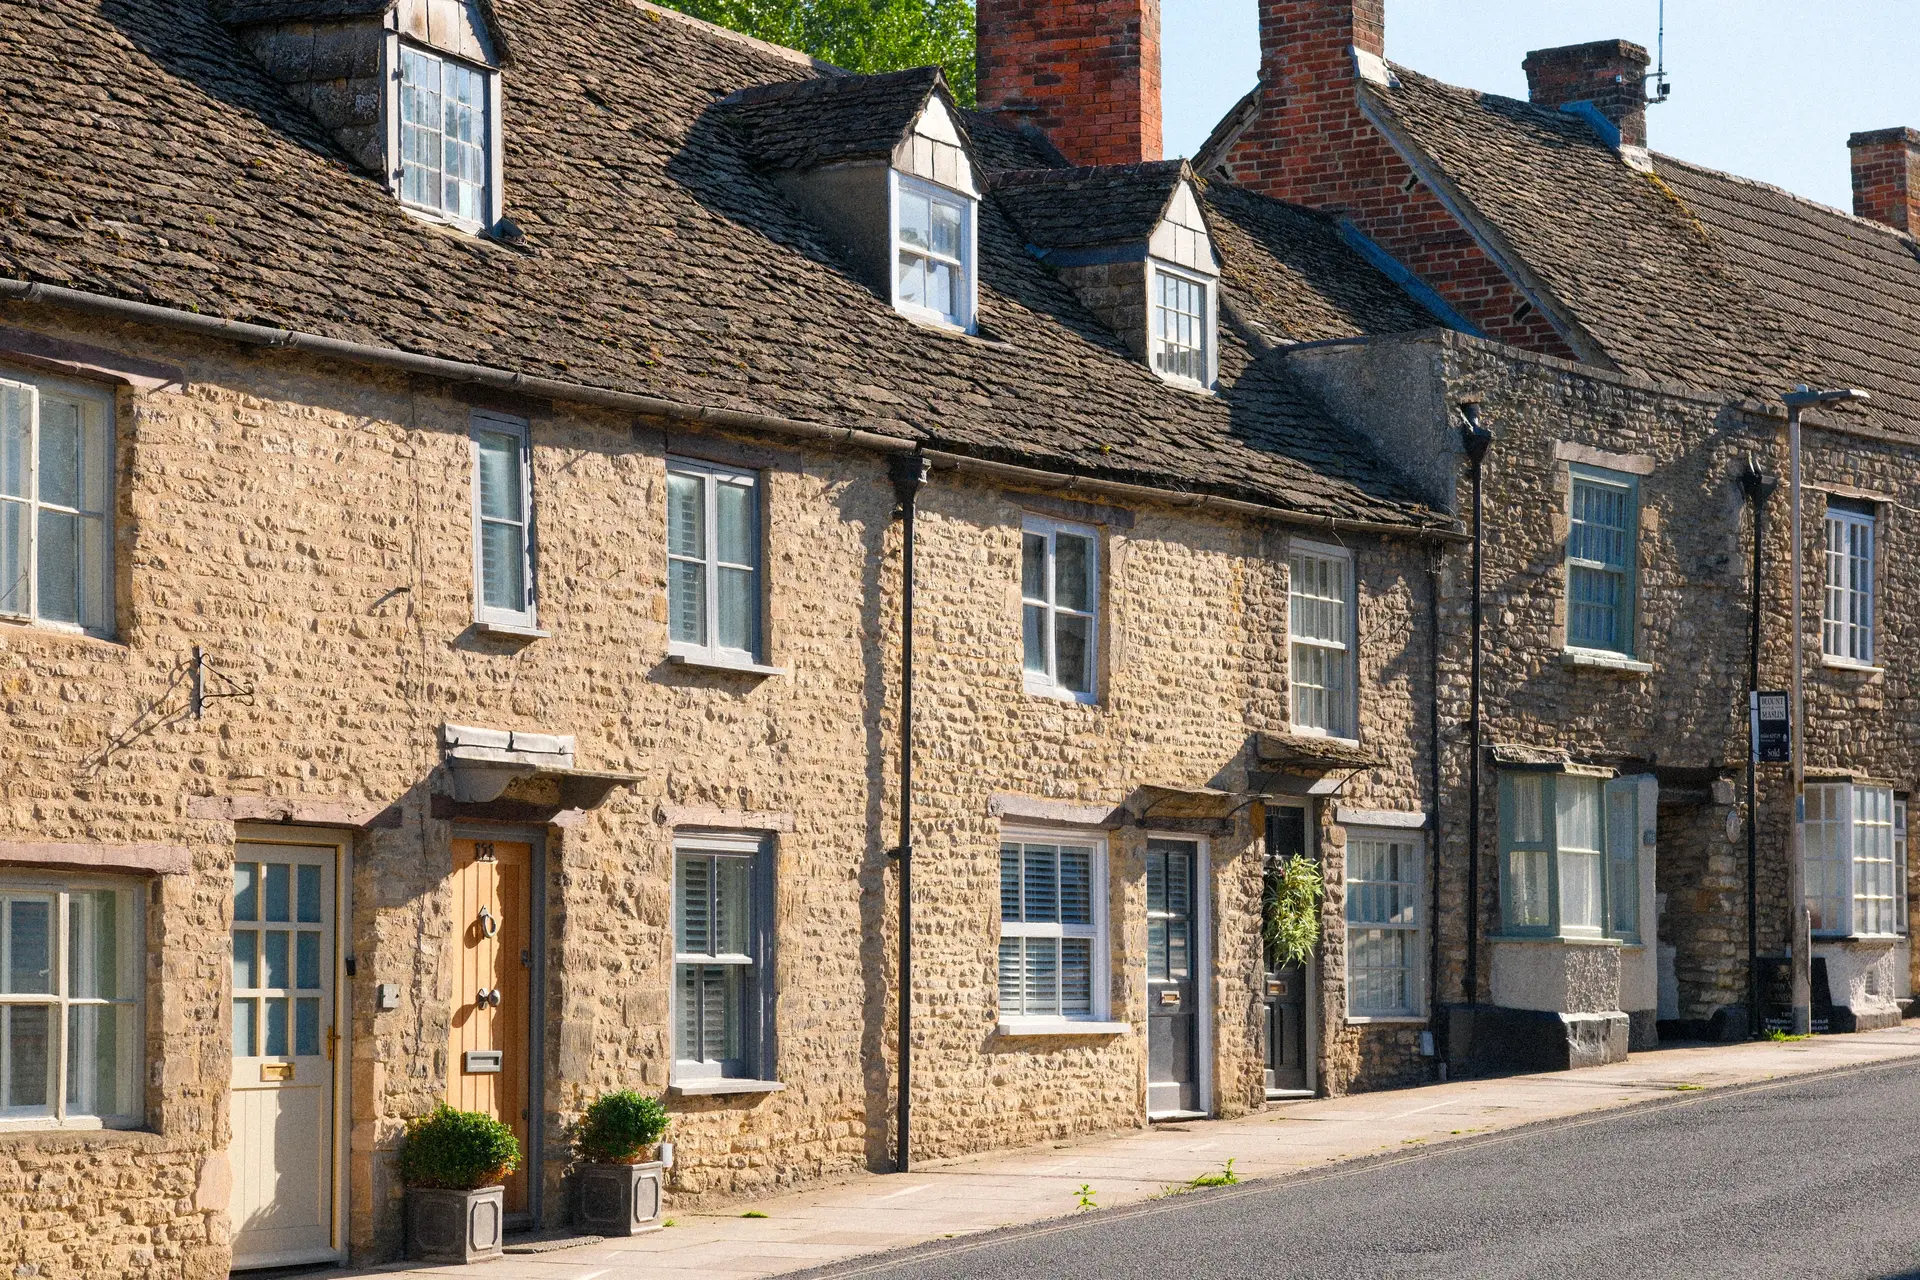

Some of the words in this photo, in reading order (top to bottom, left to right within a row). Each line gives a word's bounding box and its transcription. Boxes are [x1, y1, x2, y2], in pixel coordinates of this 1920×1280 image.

[1761, 697, 1783, 705] BLOUNT
[1762, 710, 1784, 718] MASLIN
[1767, 748, 1780, 757] Sold
